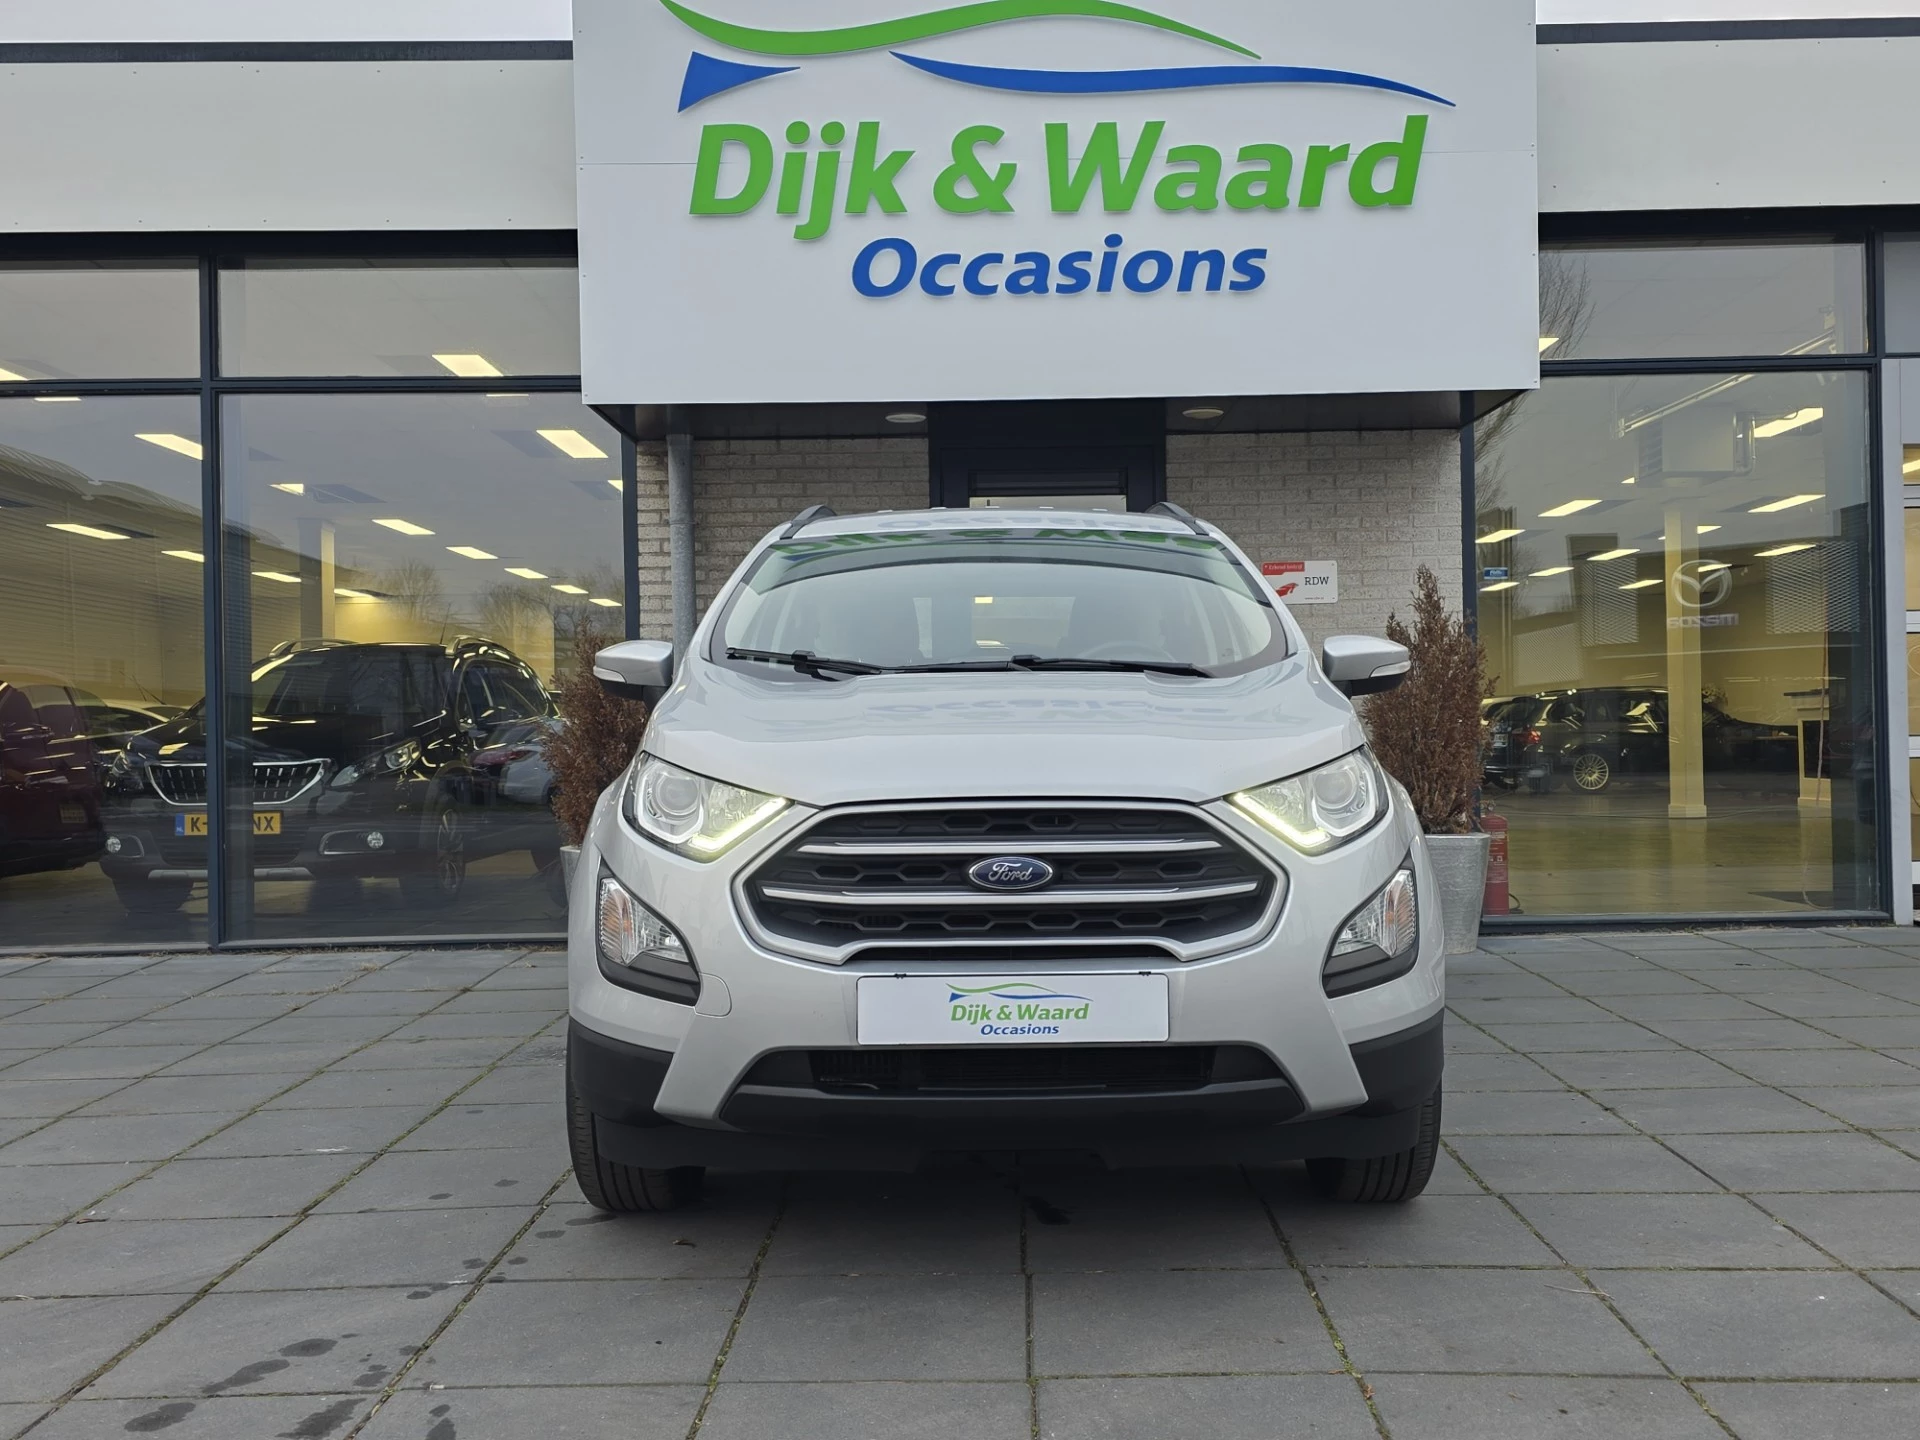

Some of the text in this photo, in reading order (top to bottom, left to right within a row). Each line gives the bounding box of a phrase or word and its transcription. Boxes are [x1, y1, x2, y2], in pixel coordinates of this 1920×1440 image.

[689, 114, 1428, 241] Dijk & Waard
[852, 233, 1268, 298] Occasions
[1304, 576, 1329, 585] RDW
[988, 862, 1033, 881] Ford
[951, 1003, 1089, 1025] Dijk & Waard
[980, 1023, 1060, 1036] Occasions
